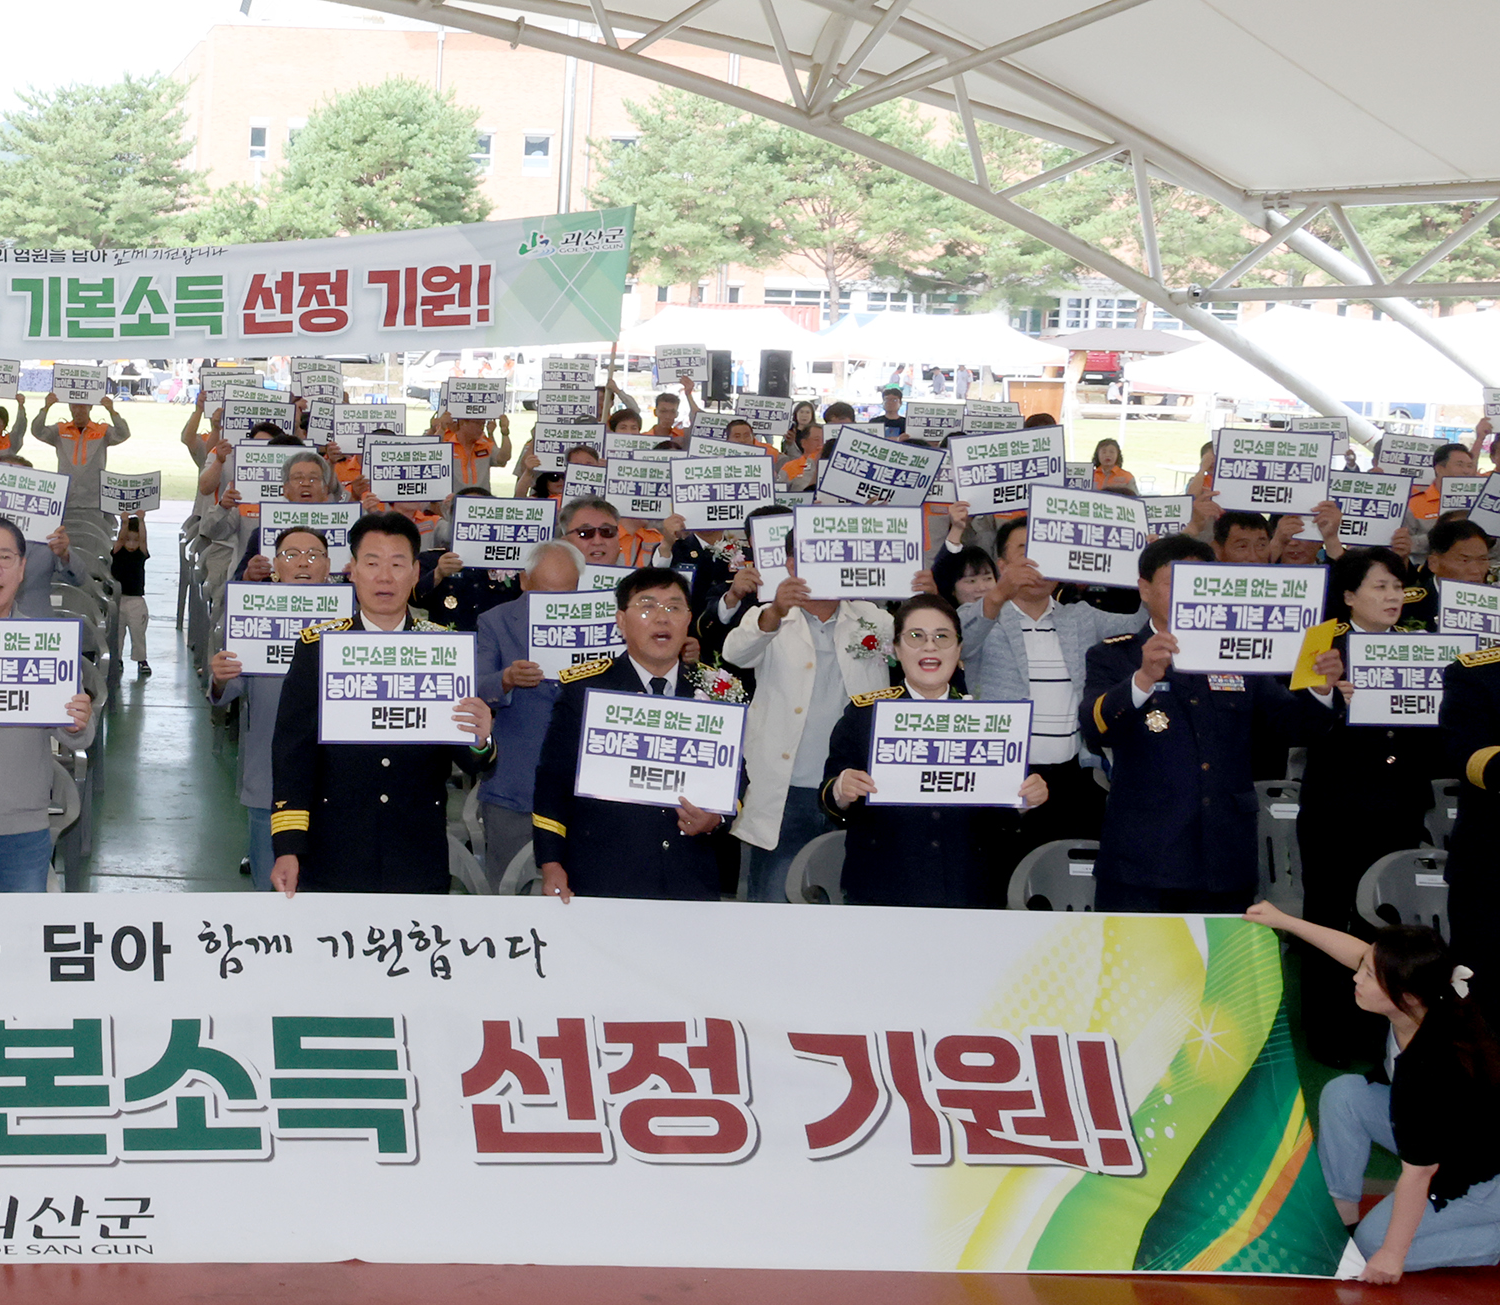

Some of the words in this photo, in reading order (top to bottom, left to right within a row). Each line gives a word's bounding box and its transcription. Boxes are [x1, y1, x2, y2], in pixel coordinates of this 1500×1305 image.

[561, 228, 624, 246] 괴산군
[12, 272, 222, 338] 기본소득
[242, 269, 349, 335] 선정
[368, 264, 491, 328] 기원!
[381, 451, 410, 461] 인구소멸
[412, 450, 426, 461] 없는
[428, 450, 442, 461] 괴산
[1233, 438, 1274, 455] 인구소멸
[1276, 441, 1296, 456] 없는
[1298, 442, 1319, 458] 괴산
[374, 466, 400, 479] 농어촌
[402, 465, 420, 478] 기본
[422, 465, 449, 478] 소득이
[686, 466, 722, 479] 인구소멸
[724, 466, 741, 478] 없는
[744, 465, 761, 478] 괴산
[1220, 458, 1259, 479] 농어촌
[1260, 461, 1286, 480] 기본
[1287, 463, 1326, 482] 소득이
[398, 482, 426, 495] 만든다!
[677, 484, 710, 501] 농어촌
[713, 484, 735, 500] 기본
[737, 483, 771, 499] 소득이
[1251, 485, 1292, 503] 만든다!
[707, 504, 743, 521] 만든다!
[1193, 576, 1248, 597] 인구소멸
[1250, 578, 1278, 598] 없는
[1280, 579, 1307, 599] 괴산
[1177, 603, 1228, 629] 농어촌
[1230, 605, 1264, 629] 기본
[1267, 607, 1318, 631] 소득이
[4, 632, 30, 651] 없는
[34, 632, 61, 651] 괴산
[1219, 637, 1273, 660] 만든다!
[1364, 644, 1410, 662] 인구소멸
[1411, 644, 1436, 662] 없는
[1437, 645, 1462, 662] 괴산
[22, 659, 73, 683] 소득이
[1353, 667, 1397, 689] 농어촌
[1401, 667, 1428, 688] 기본
[1389, 694, 1436, 715] 만든다!
[605, 704, 661, 728] 인구소멸
[663, 710, 692, 731] 없는
[695, 714, 724, 735] 괴산
[587, 728, 640, 758] 농어촌
[641, 735, 677, 761] 기본
[679, 739, 735, 768] 소득이
[628, 765, 686, 793] 만든다!
[43, 921, 172, 982] 담아
[197, 920, 293, 980] 함께
[316, 920, 548, 980] 기원합니다
[461, 1015, 750, 1158] 선정
[790, 1028, 1140, 1170] 기원!
[26, 1244, 83, 1255] SAN
[91, 1244, 154, 1255] GUN
